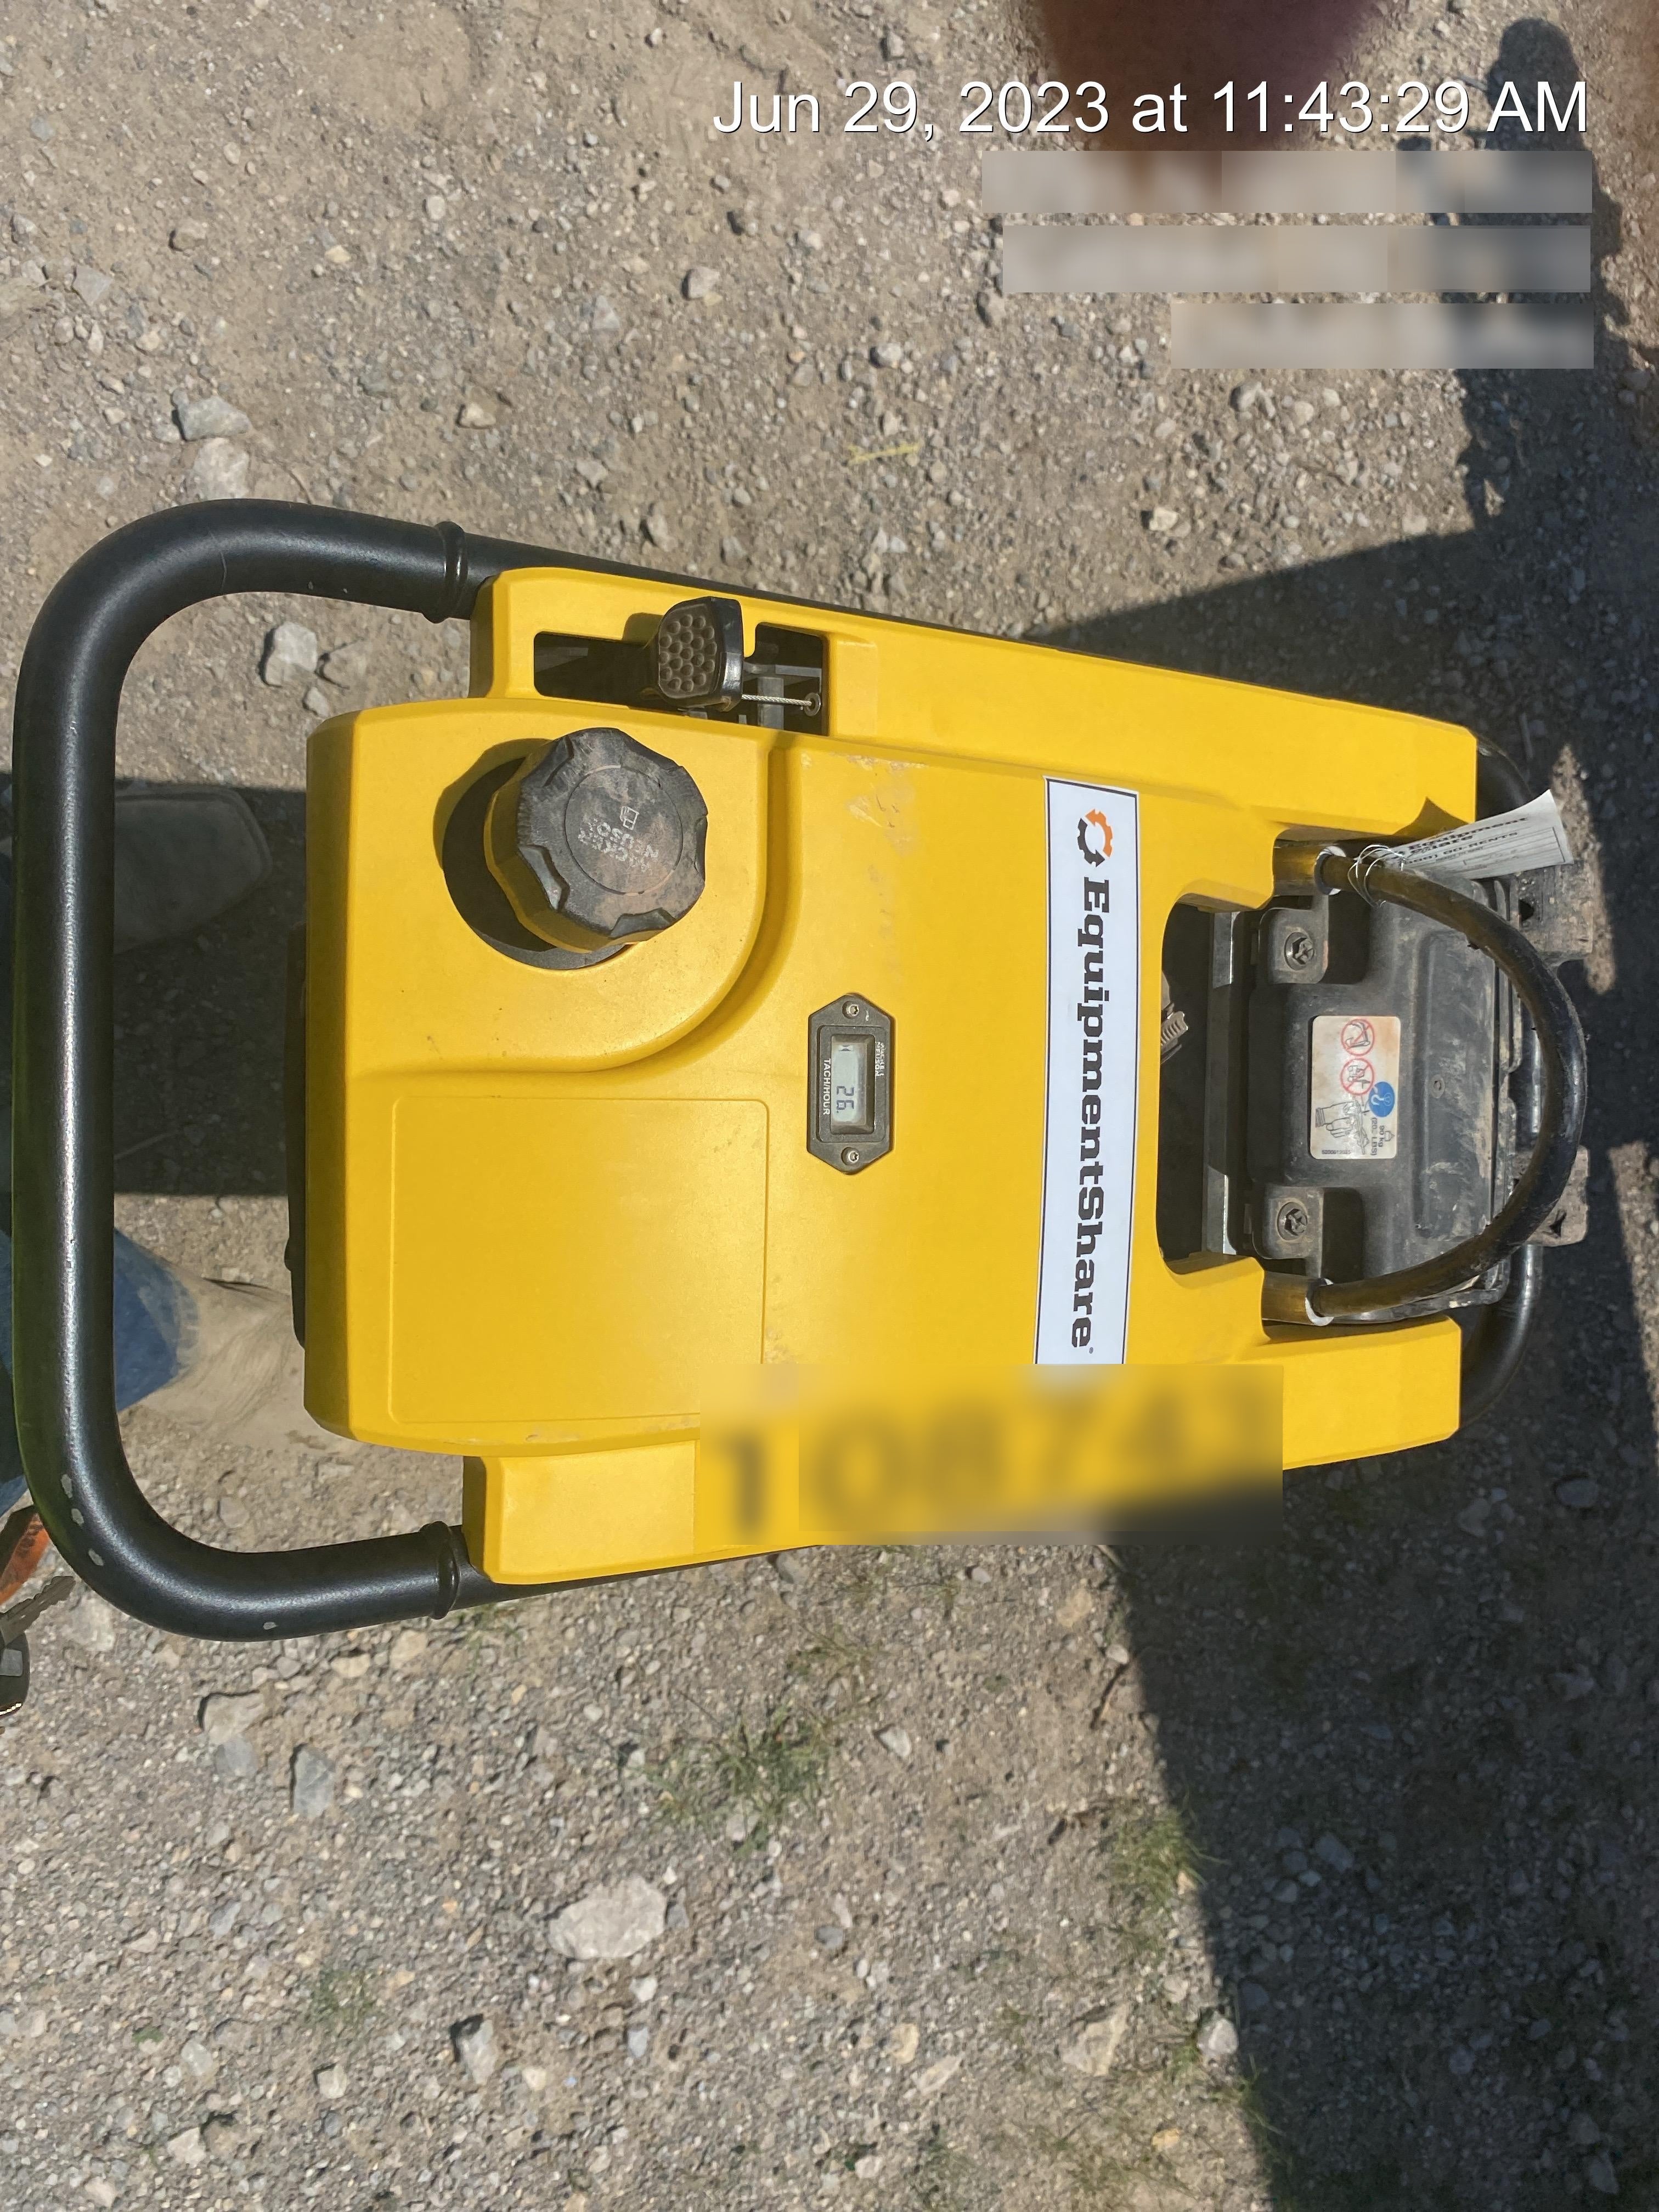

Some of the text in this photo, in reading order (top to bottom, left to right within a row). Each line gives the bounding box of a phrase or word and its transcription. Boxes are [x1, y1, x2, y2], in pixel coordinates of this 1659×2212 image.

[823, 1058, 831, 1116] TACH/HOUR
[1071, 877, 1109, 1348] EquipmentShare
[1378, 1125, 1385, 1148] 90 kg
